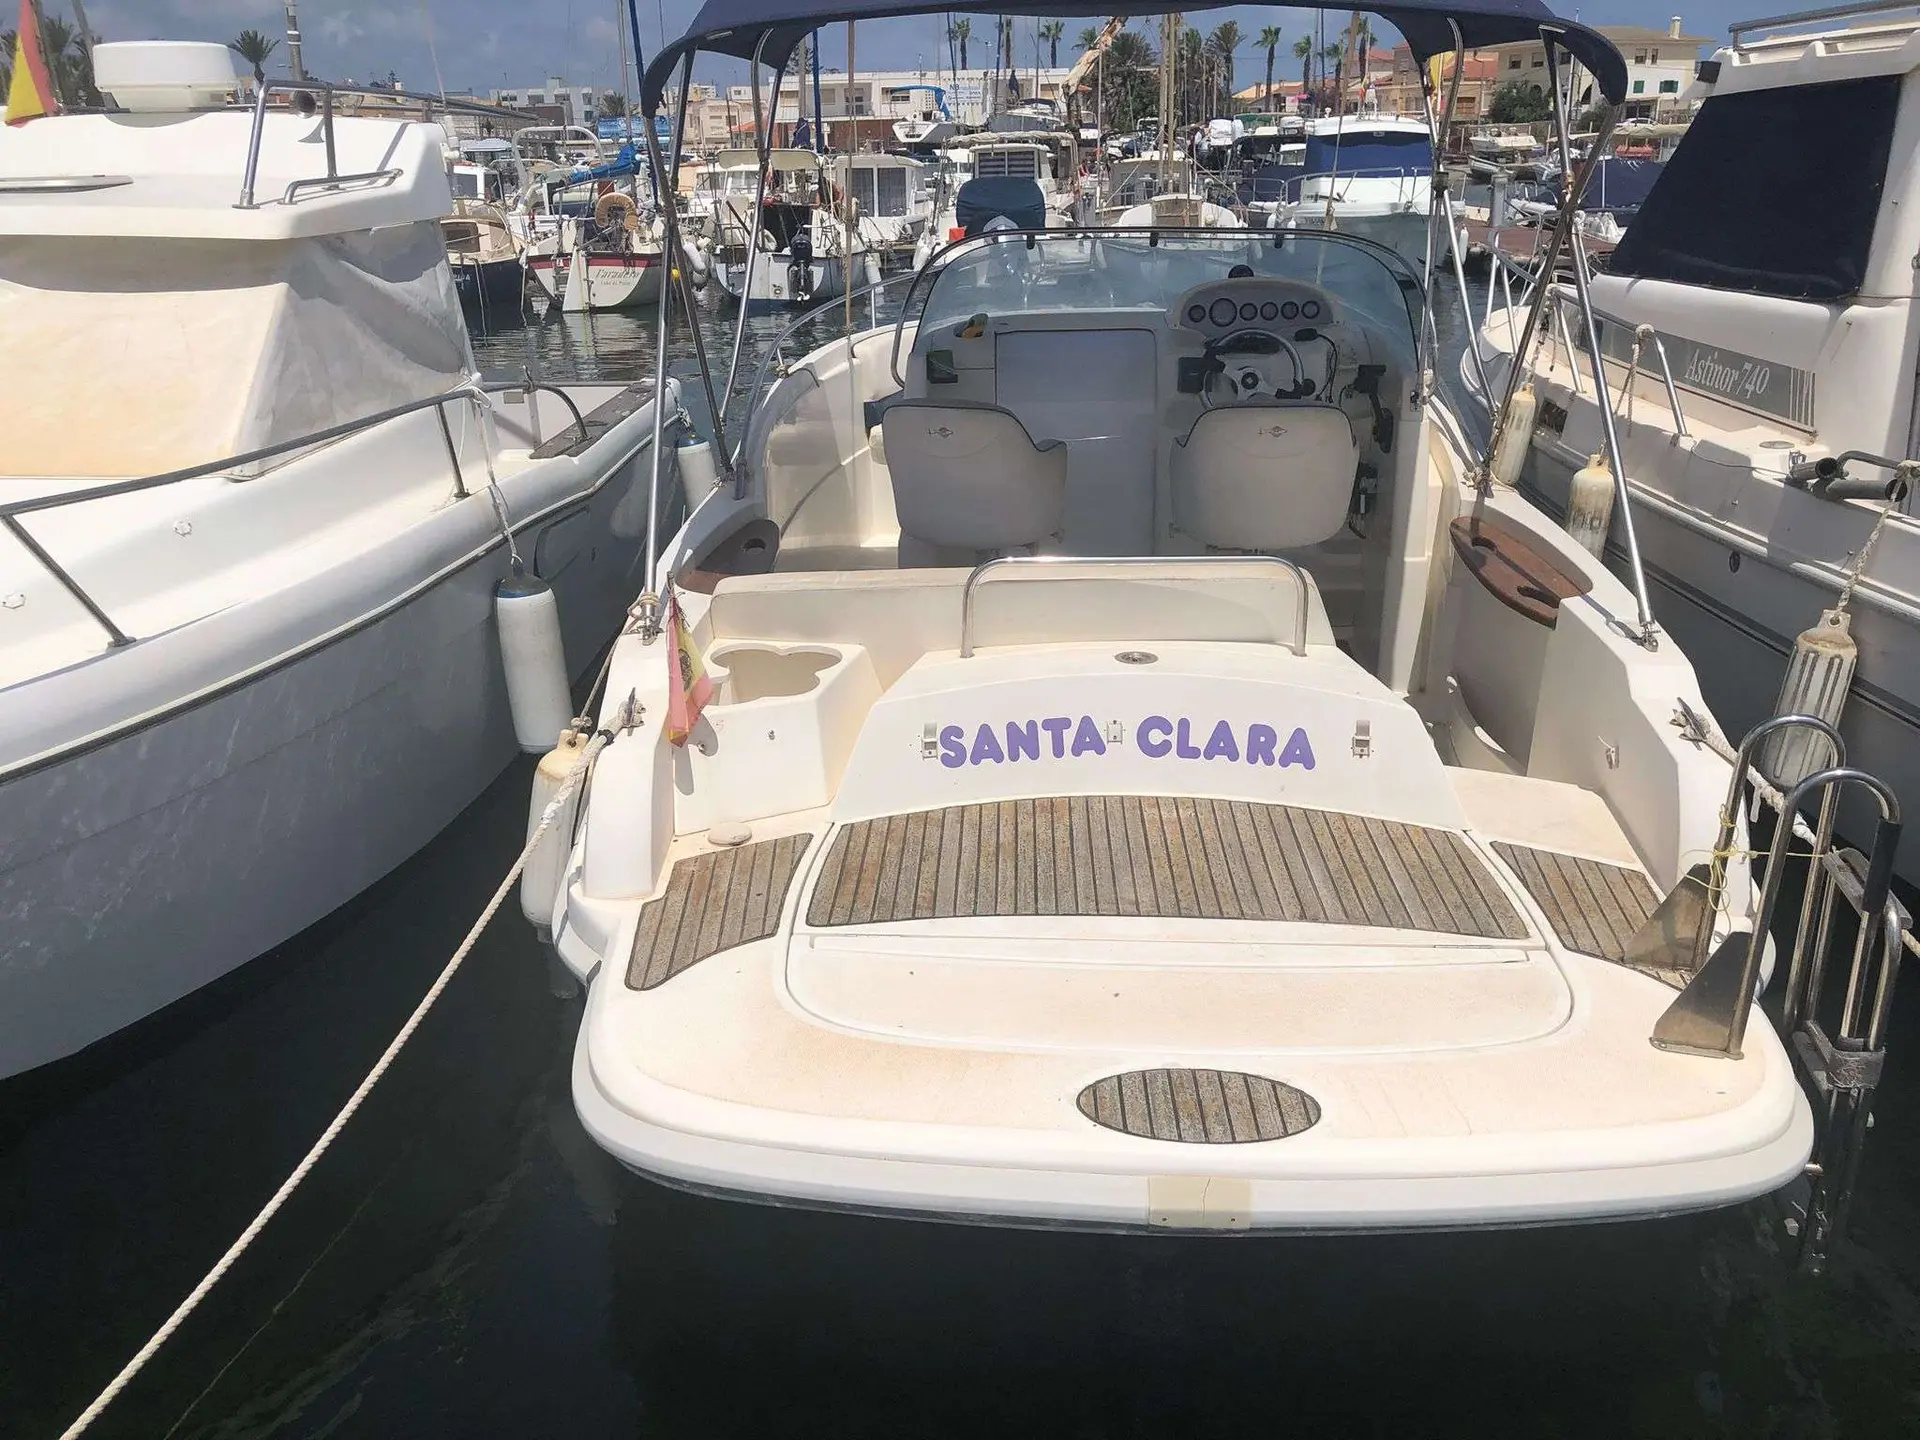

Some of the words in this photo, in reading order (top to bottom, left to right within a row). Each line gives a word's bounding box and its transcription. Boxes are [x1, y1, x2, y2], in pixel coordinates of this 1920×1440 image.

[1684, 348, 1740, 394] Astinor
[1735, 361, 1770, 399] 740
[940, 716, 1106, 768] SANTA
[1137, 715, 1316, 771] CLARA
